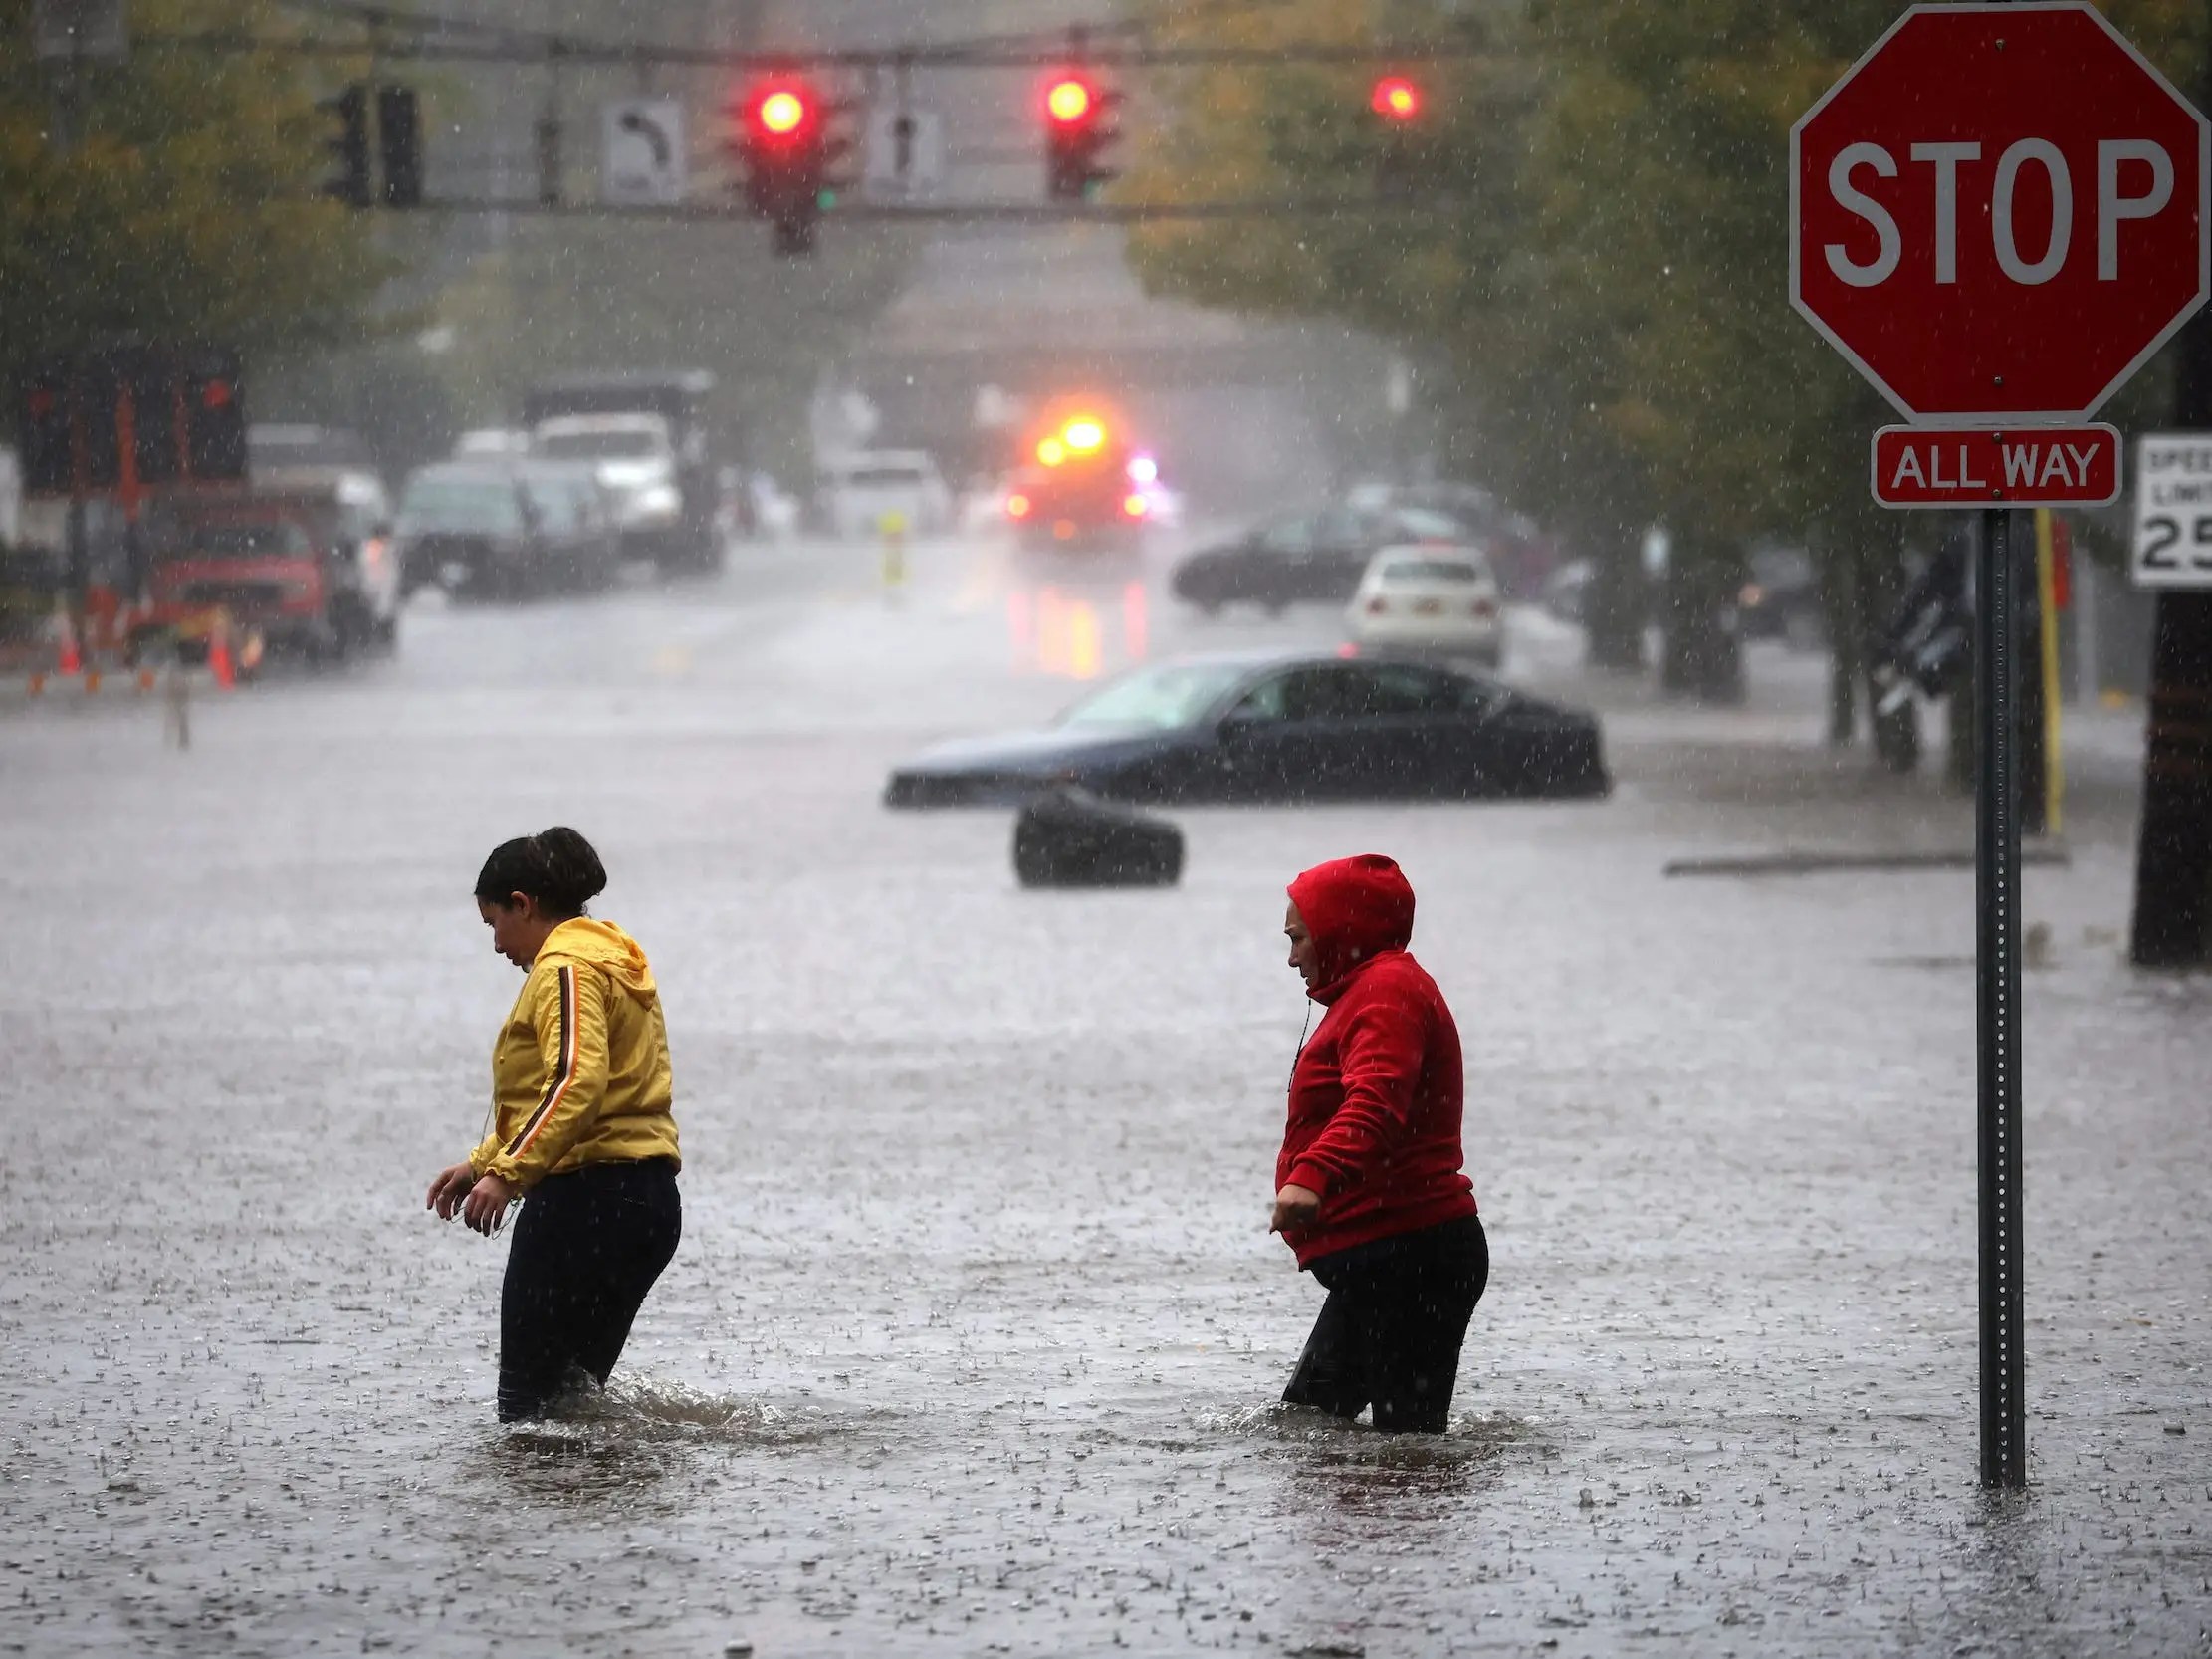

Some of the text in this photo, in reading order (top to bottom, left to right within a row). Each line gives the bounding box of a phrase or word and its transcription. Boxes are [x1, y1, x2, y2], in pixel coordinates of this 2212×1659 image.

[1824, 138, 2174, 287] STOP
[1892, 444, 2100, 488] ALL WAY
